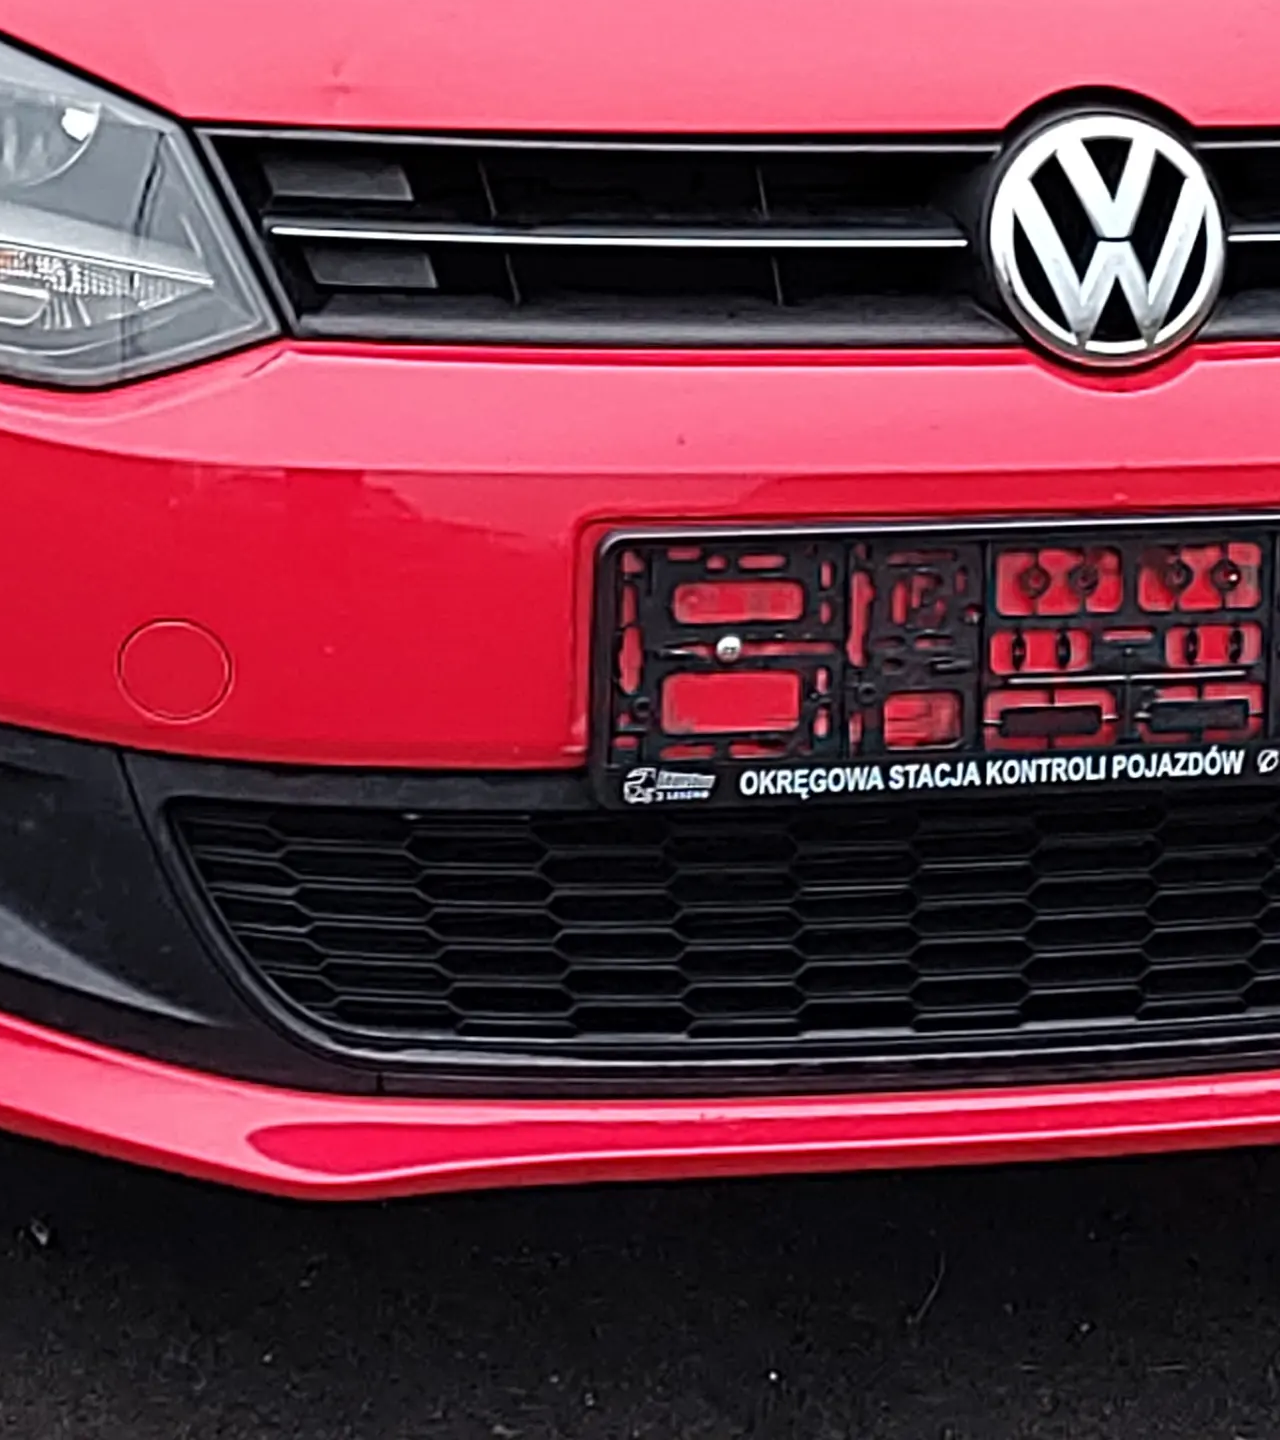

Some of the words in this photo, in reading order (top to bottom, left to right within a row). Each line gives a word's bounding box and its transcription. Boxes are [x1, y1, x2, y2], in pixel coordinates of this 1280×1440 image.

[738, 765, 885, 800] OKRĘGOWA
[888, 761, 982, 790] STACJA
[985, 756, 1107, 786] KONTROLI
[1111, 744, 1245, 780] POJAZDÓW
